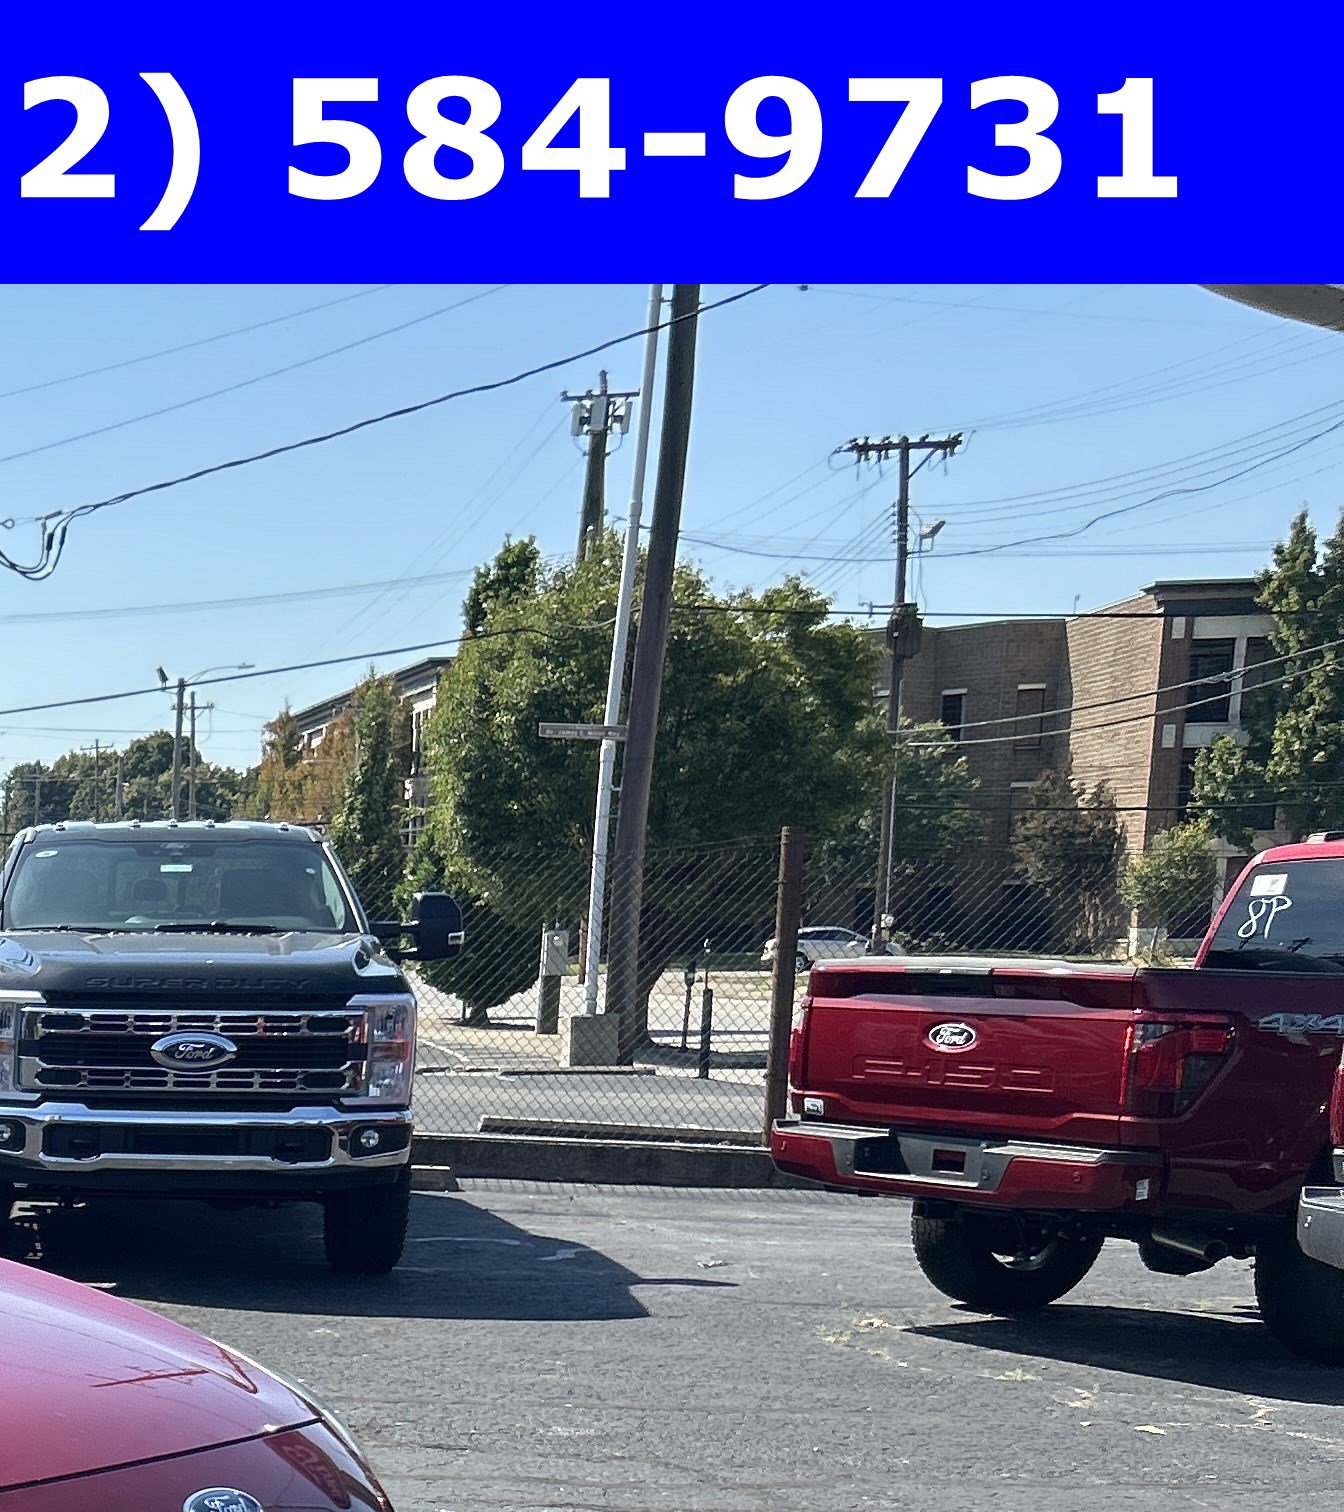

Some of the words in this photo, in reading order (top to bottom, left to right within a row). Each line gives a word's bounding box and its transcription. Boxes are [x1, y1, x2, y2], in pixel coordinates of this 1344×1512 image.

[85, 976, 208, 989] SUPER
[215, 977, 311, 990] DUTY
[935, 1026, 968, 1044] Ford
[174, 1043, 216, 1059] Ford
